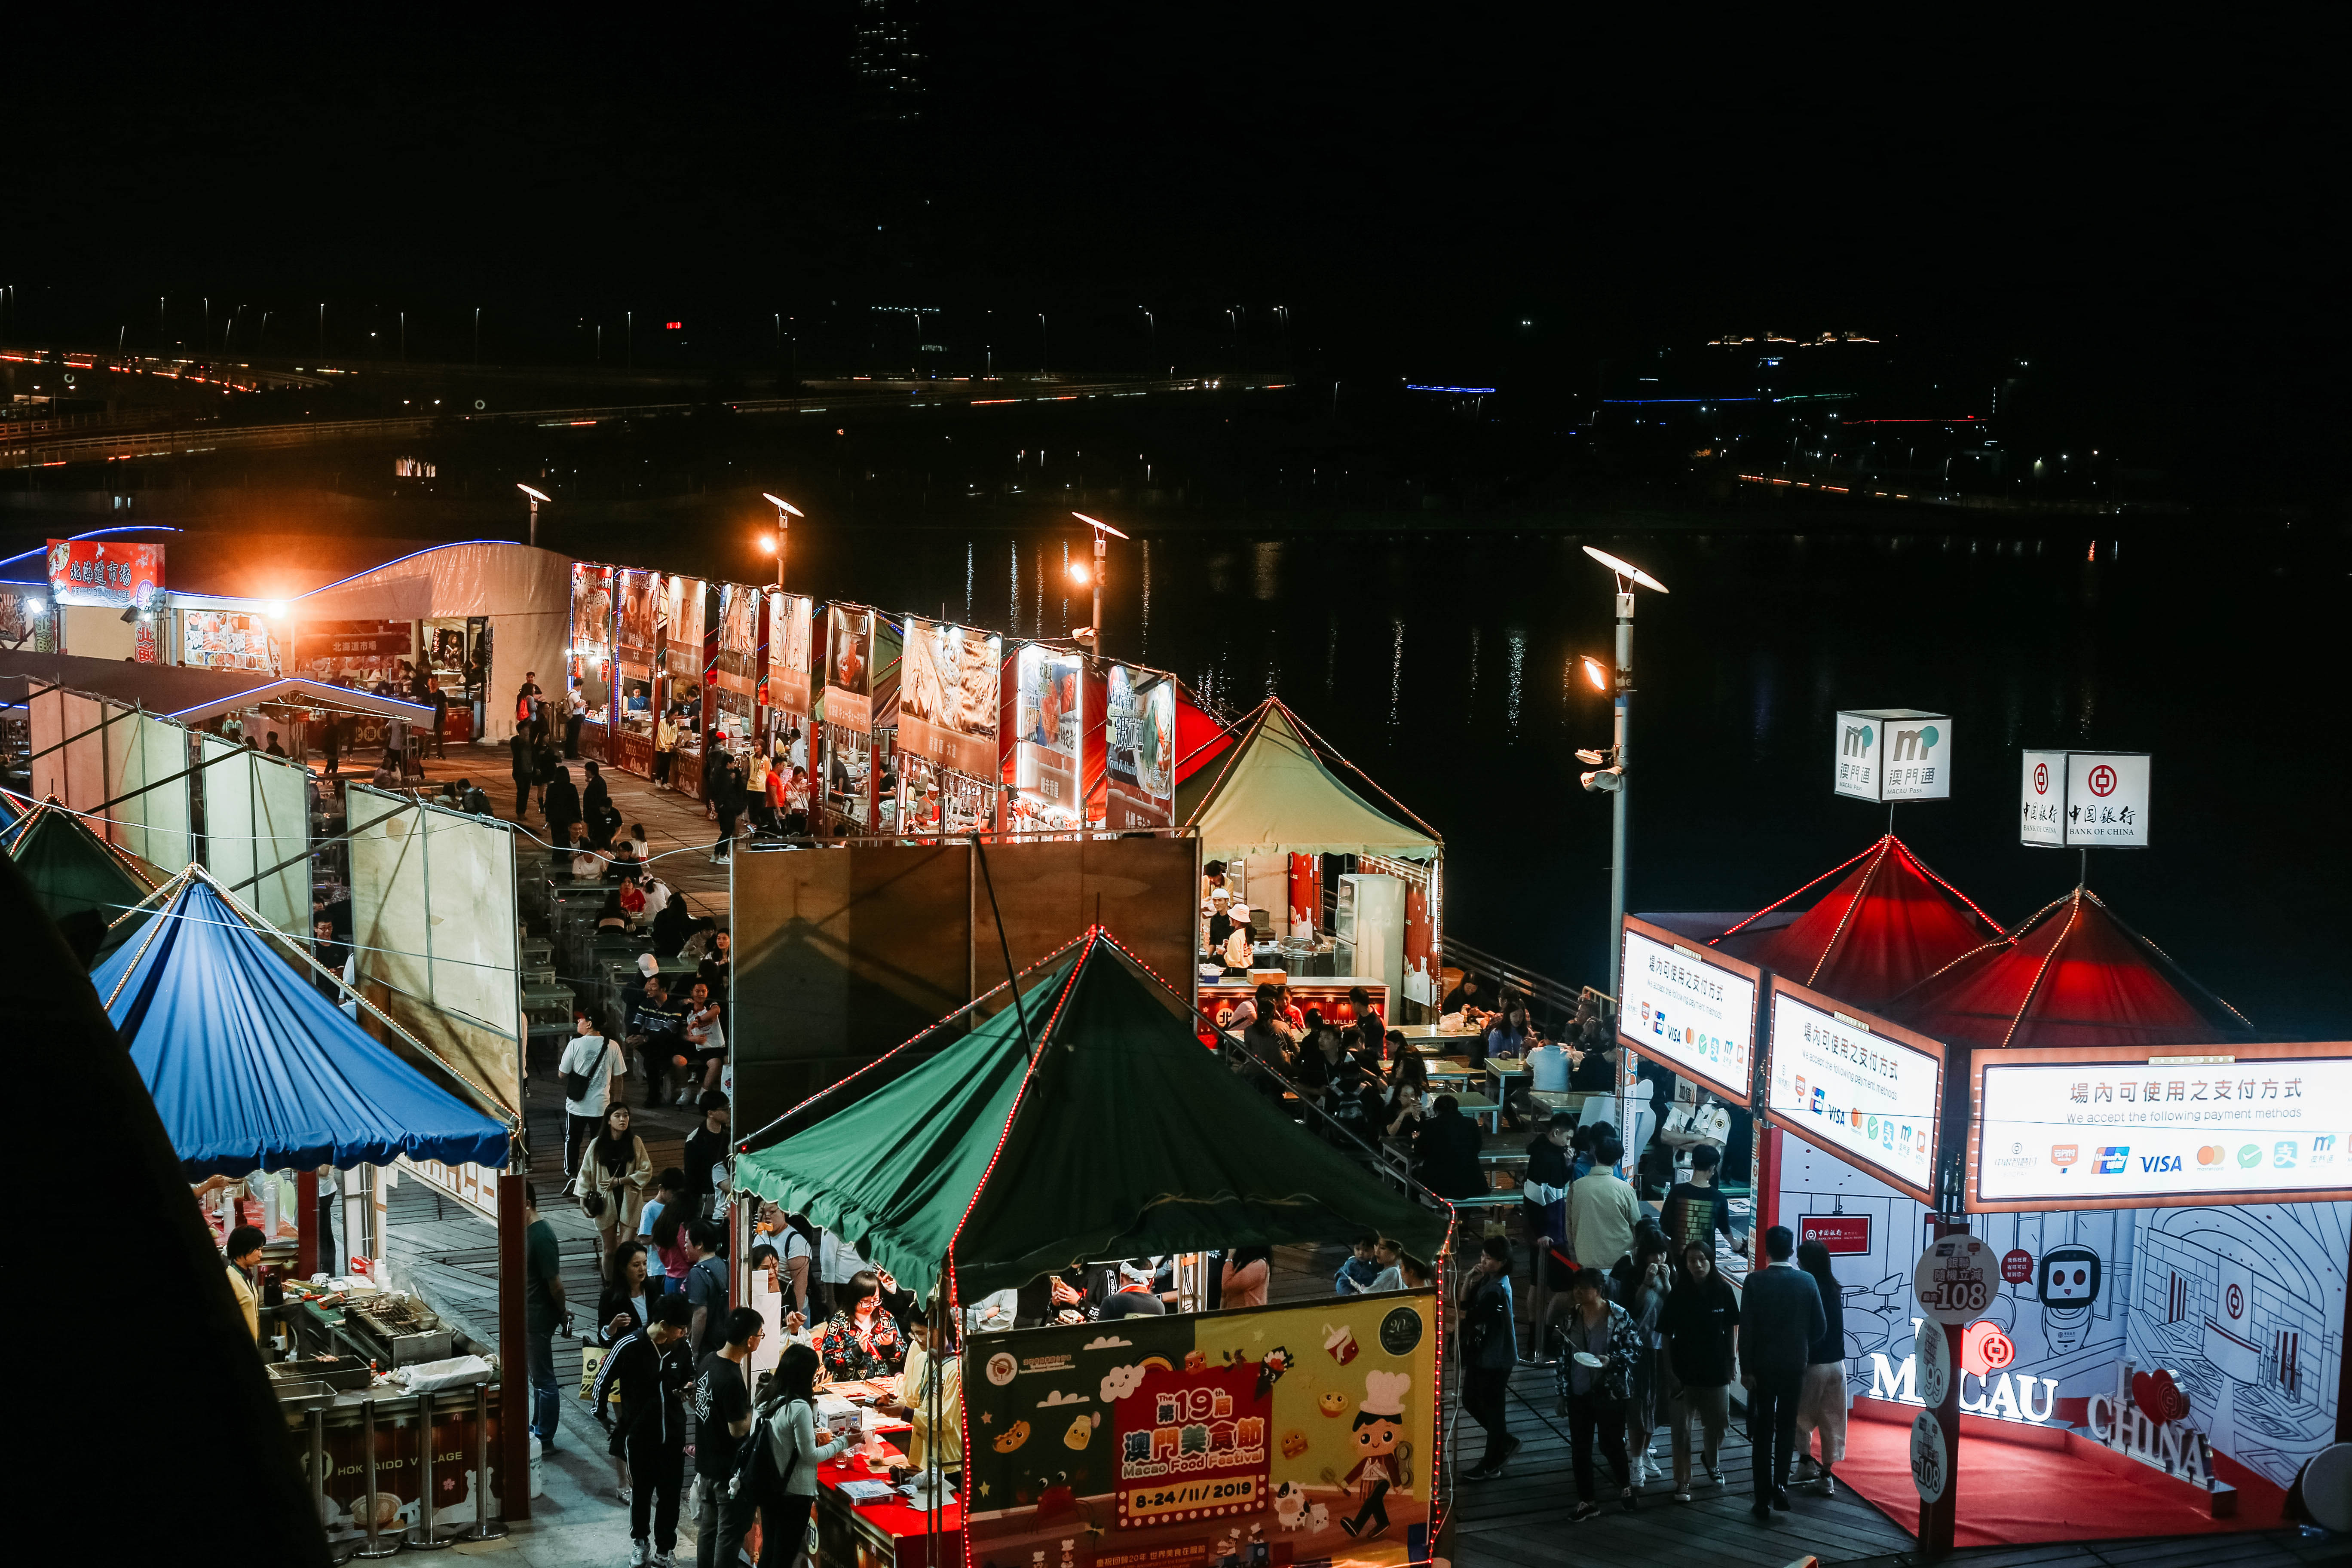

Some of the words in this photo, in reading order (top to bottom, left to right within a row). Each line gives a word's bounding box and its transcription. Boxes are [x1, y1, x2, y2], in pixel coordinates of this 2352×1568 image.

[70, 560, 132, 587] 北海道市場
[71, 586, 102, 597] HOKKAIDO
[104, 589, 129, 599] VILLAGE
[333, 640, 377, 652] 北海道市場
[1840, 763, 1871, 784] 澳門通
[1888, 767, 1936, 786] 澳門通
[1649, 954, 1723, 1002] 場內可使用之支付方式
[1667, 1024, 1681, 1044] VISA
[1804, 1021, 1898, 1081] 場內可使用之支付方式
[1802, 1048, 1810, 1059] We
[1810, 1053, 1825, 1068] accept
[1833, 1063, 1854, 1082] following
[1855, 1074, 1875, 1091] payment
[1876, 1082, 1897, 1100] methods
[2070, 1078, 2302, 1103] 場內可使用之支付方式
[1828, 1104, 1845, 1127] VISA
[2067, 1113, 2083, 1123] We
[2087, 1112, 2125, 1123] accept
[2128, 1112, 2146, 1121] the
[2150, 1110, 2201, 1121] following
[2204, 1109, 2251, 1121] payment
[2255, 1107, 2302, 1118] methods
[2138, 1155, 2182, 1173] VISA
[1936, 1282, 1986, 1310] 108
[1868, 1352, 2059, 1422] MCAU
[1924, 1363, 1944, 1403] 99
[1123, 1417, 1265, 1464] 澳門美食節
[2088, 1393, 2207, 1480] CHINA
[337, 1459, 403, 1476] HOKAIDO
[1123, 1463, 1167, 1478] Macao
[1170, 1458, 1204, 1472] Food
[1209, 1450, 1263, 1466] Festival
[1918, 1458, 1940, 1494] 108
